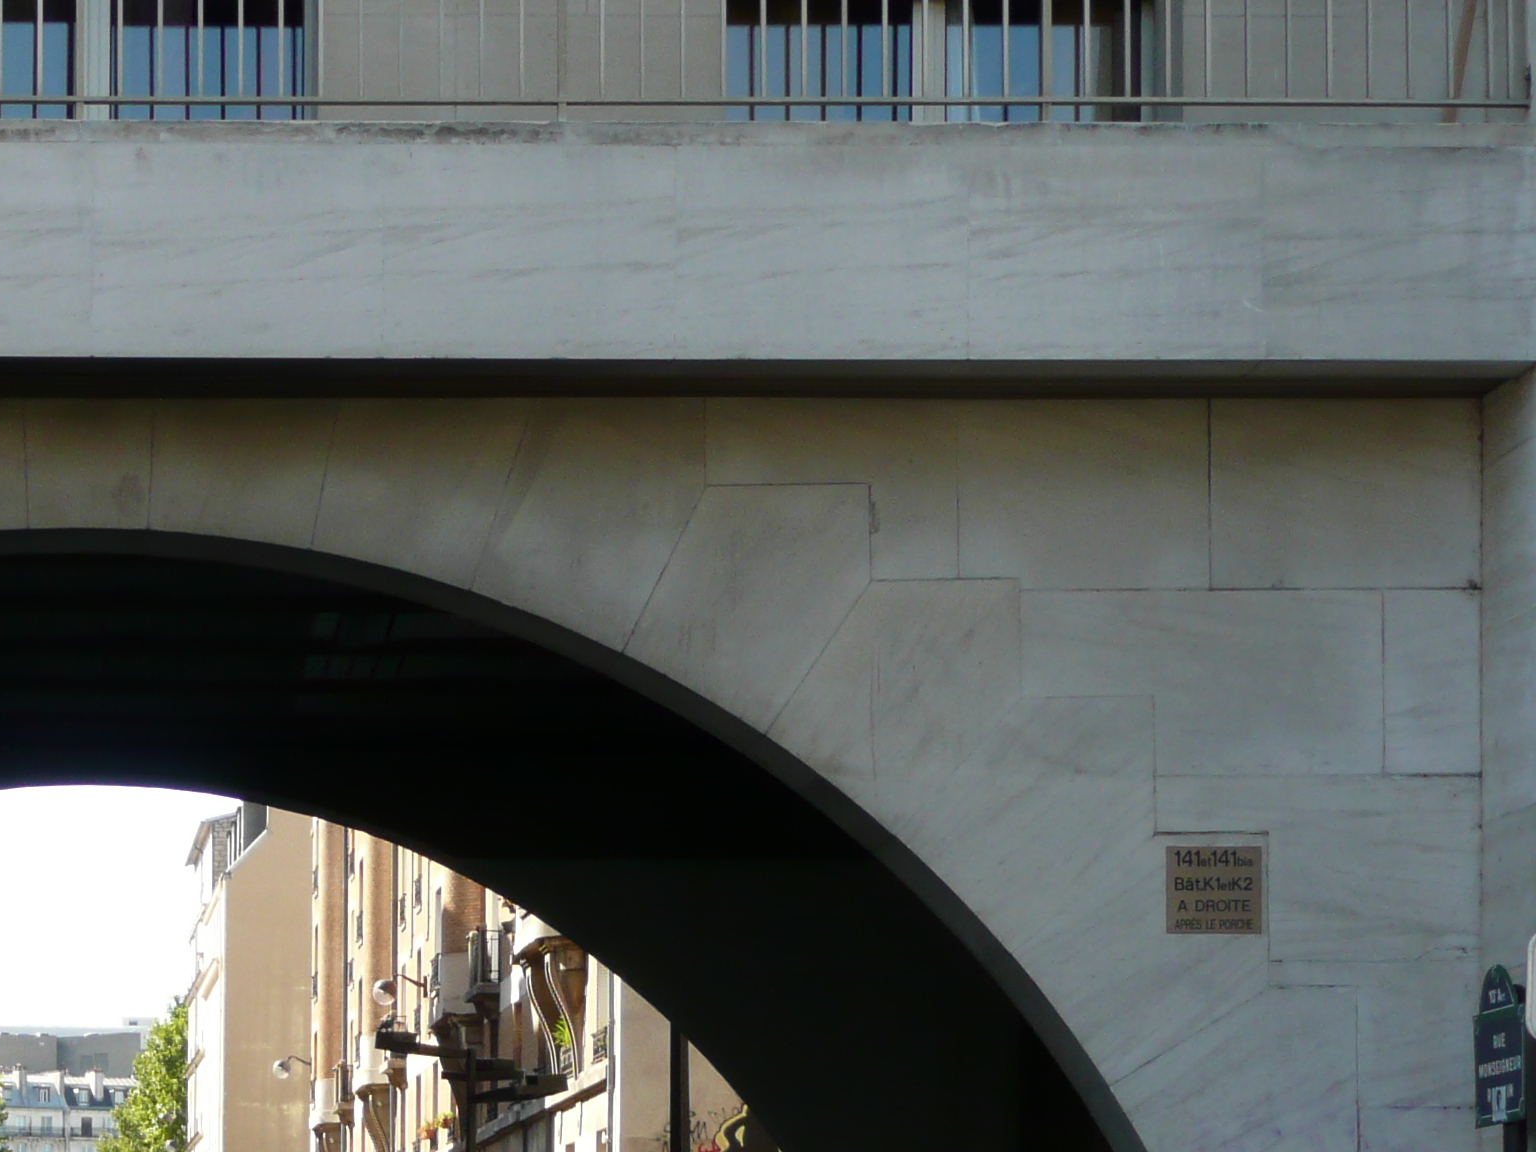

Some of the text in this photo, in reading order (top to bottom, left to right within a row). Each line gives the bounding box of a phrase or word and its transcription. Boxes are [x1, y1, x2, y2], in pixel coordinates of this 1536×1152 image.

[1174, 850, 1201, 867] 141
[1211, 850, 1237, 867] 141
[1237, 856, 1253, 867] bis
[1232, 877, 1253, 891] K2
[1177, 900, 1251, 912] A DROITE
[1206, 919, 1217, 930] LE
[1219, 919, 1253, 930] PORCHE
